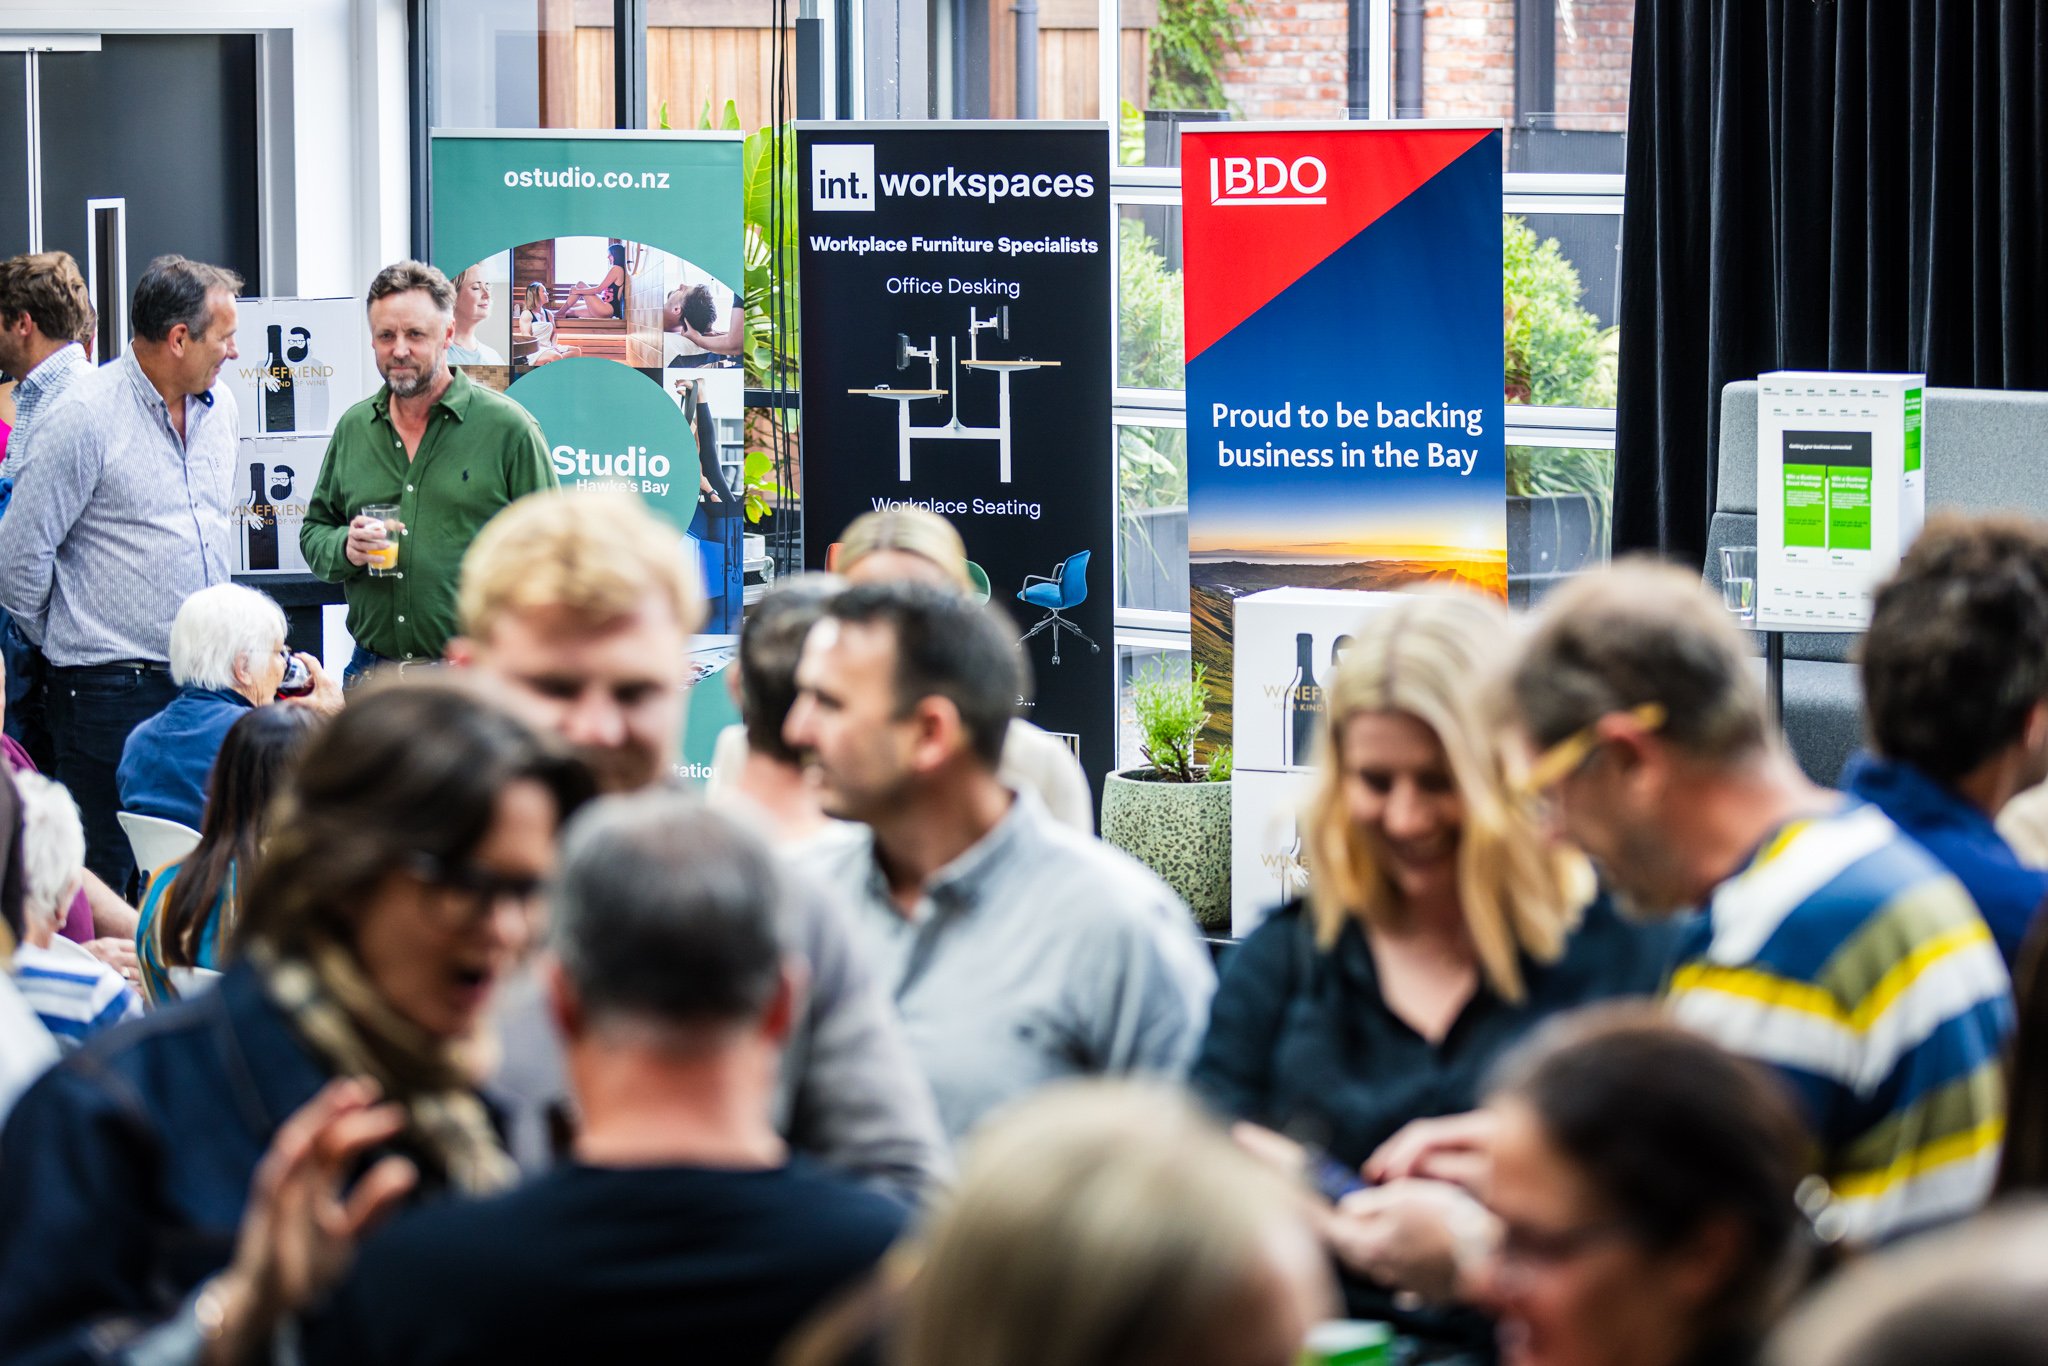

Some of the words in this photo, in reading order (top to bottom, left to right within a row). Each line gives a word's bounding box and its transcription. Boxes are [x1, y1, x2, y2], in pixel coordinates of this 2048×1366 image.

[504, 166, 670, 189] ostudio.co.nz
[819, 169, 868, 200] int.
[880, 166, 1095, 204] workspaces
[1218, 156, 1327, 199] BDO
[810, 236, 907, 256] Workplace
[911, 236, 994, 253] Furniture
[998, 236, 1099, 257] Specialists
[886, 277, 943, 295] Office
[948, 278, 1020, 299] Desking
[239, 365, 334, 380] WINEFRIEND
[305, 379, 327, 387] WINE
[1213, 402, 1291, 428] Proud
[1297, 405, 1328, 428] to
[1336, 402, 1369, 428] be
[1377, 402, 1483, 436] backing
[551, 445, 670, 478] Studio
[1218, 441, 1333, 468] business
[1341, 441, 1365, 467] in
[1371, 441, 1419, 468] the
[1428, 443, 1478, 476] Bay
[576, 479, 639, 494] Hawke's
[642, 480, 670, 497] Bay
[872, 498, 968, 517] Workplace
[972, 499, 1042, 520] Seating
